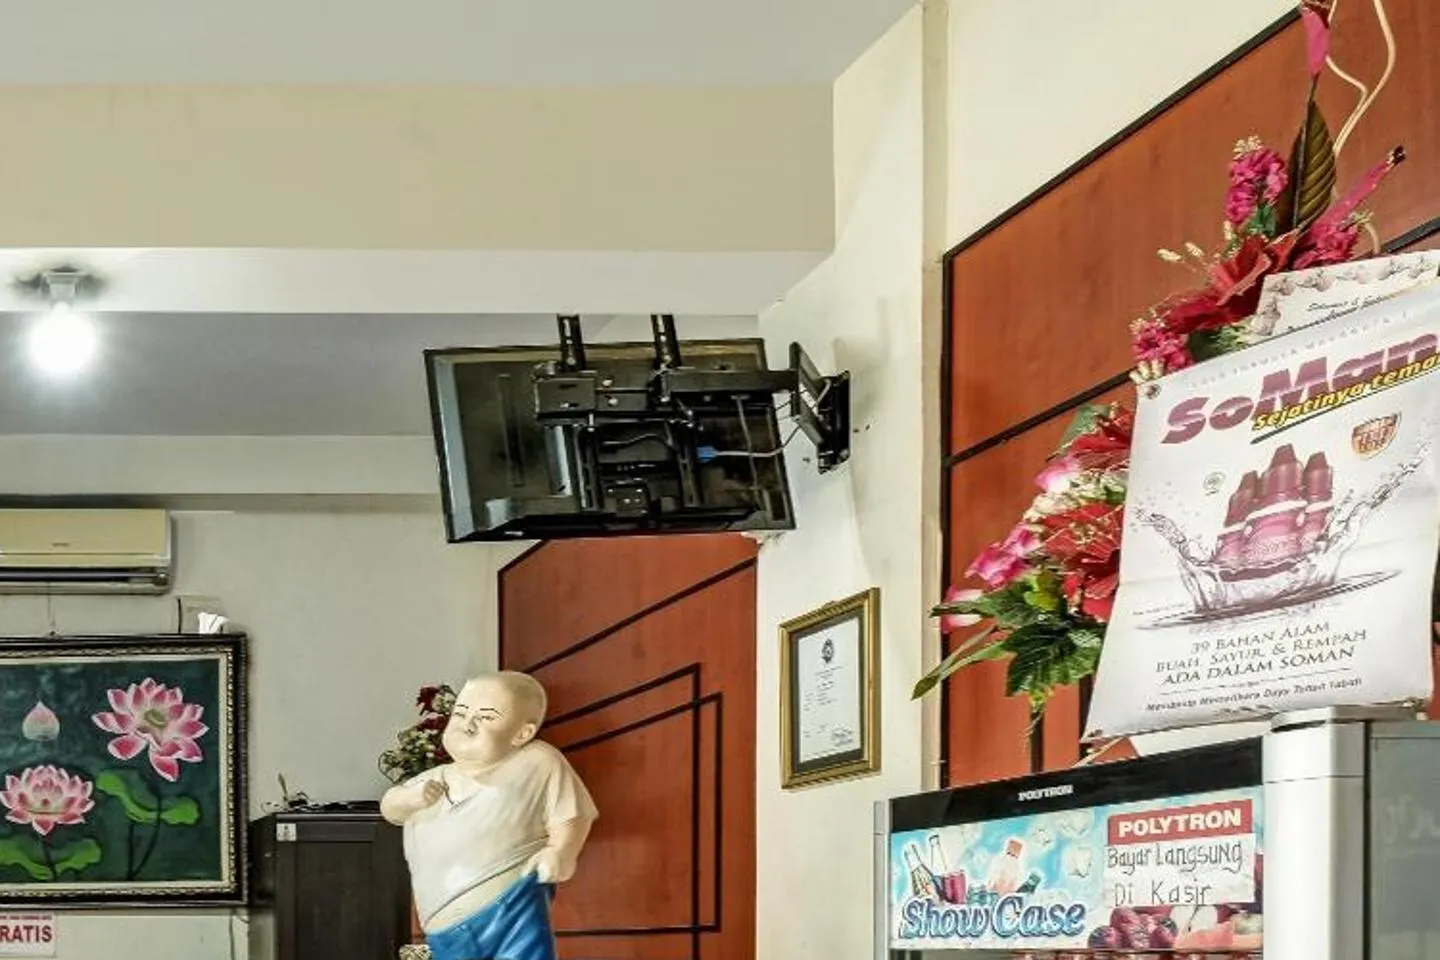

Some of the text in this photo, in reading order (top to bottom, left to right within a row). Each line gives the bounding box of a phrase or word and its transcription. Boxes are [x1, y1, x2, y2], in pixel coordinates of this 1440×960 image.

[1371, 353, 1440, 389] tema
[1210, 648, 1265, 664] SAYUR
[1272, 643, 1287, 655] &
[1293, 629, 1366, 651] REMPAH
[1216, 631, 1274, 650] BAHAN
[1280, 622, 1329, 641] ALAM
[1162, 646, 1354, 685] ADA DALAM SOMAN
[1118, 808, 1242, 838] POLYTRON
[1114, 877, 1212, 907] Di Kasir
